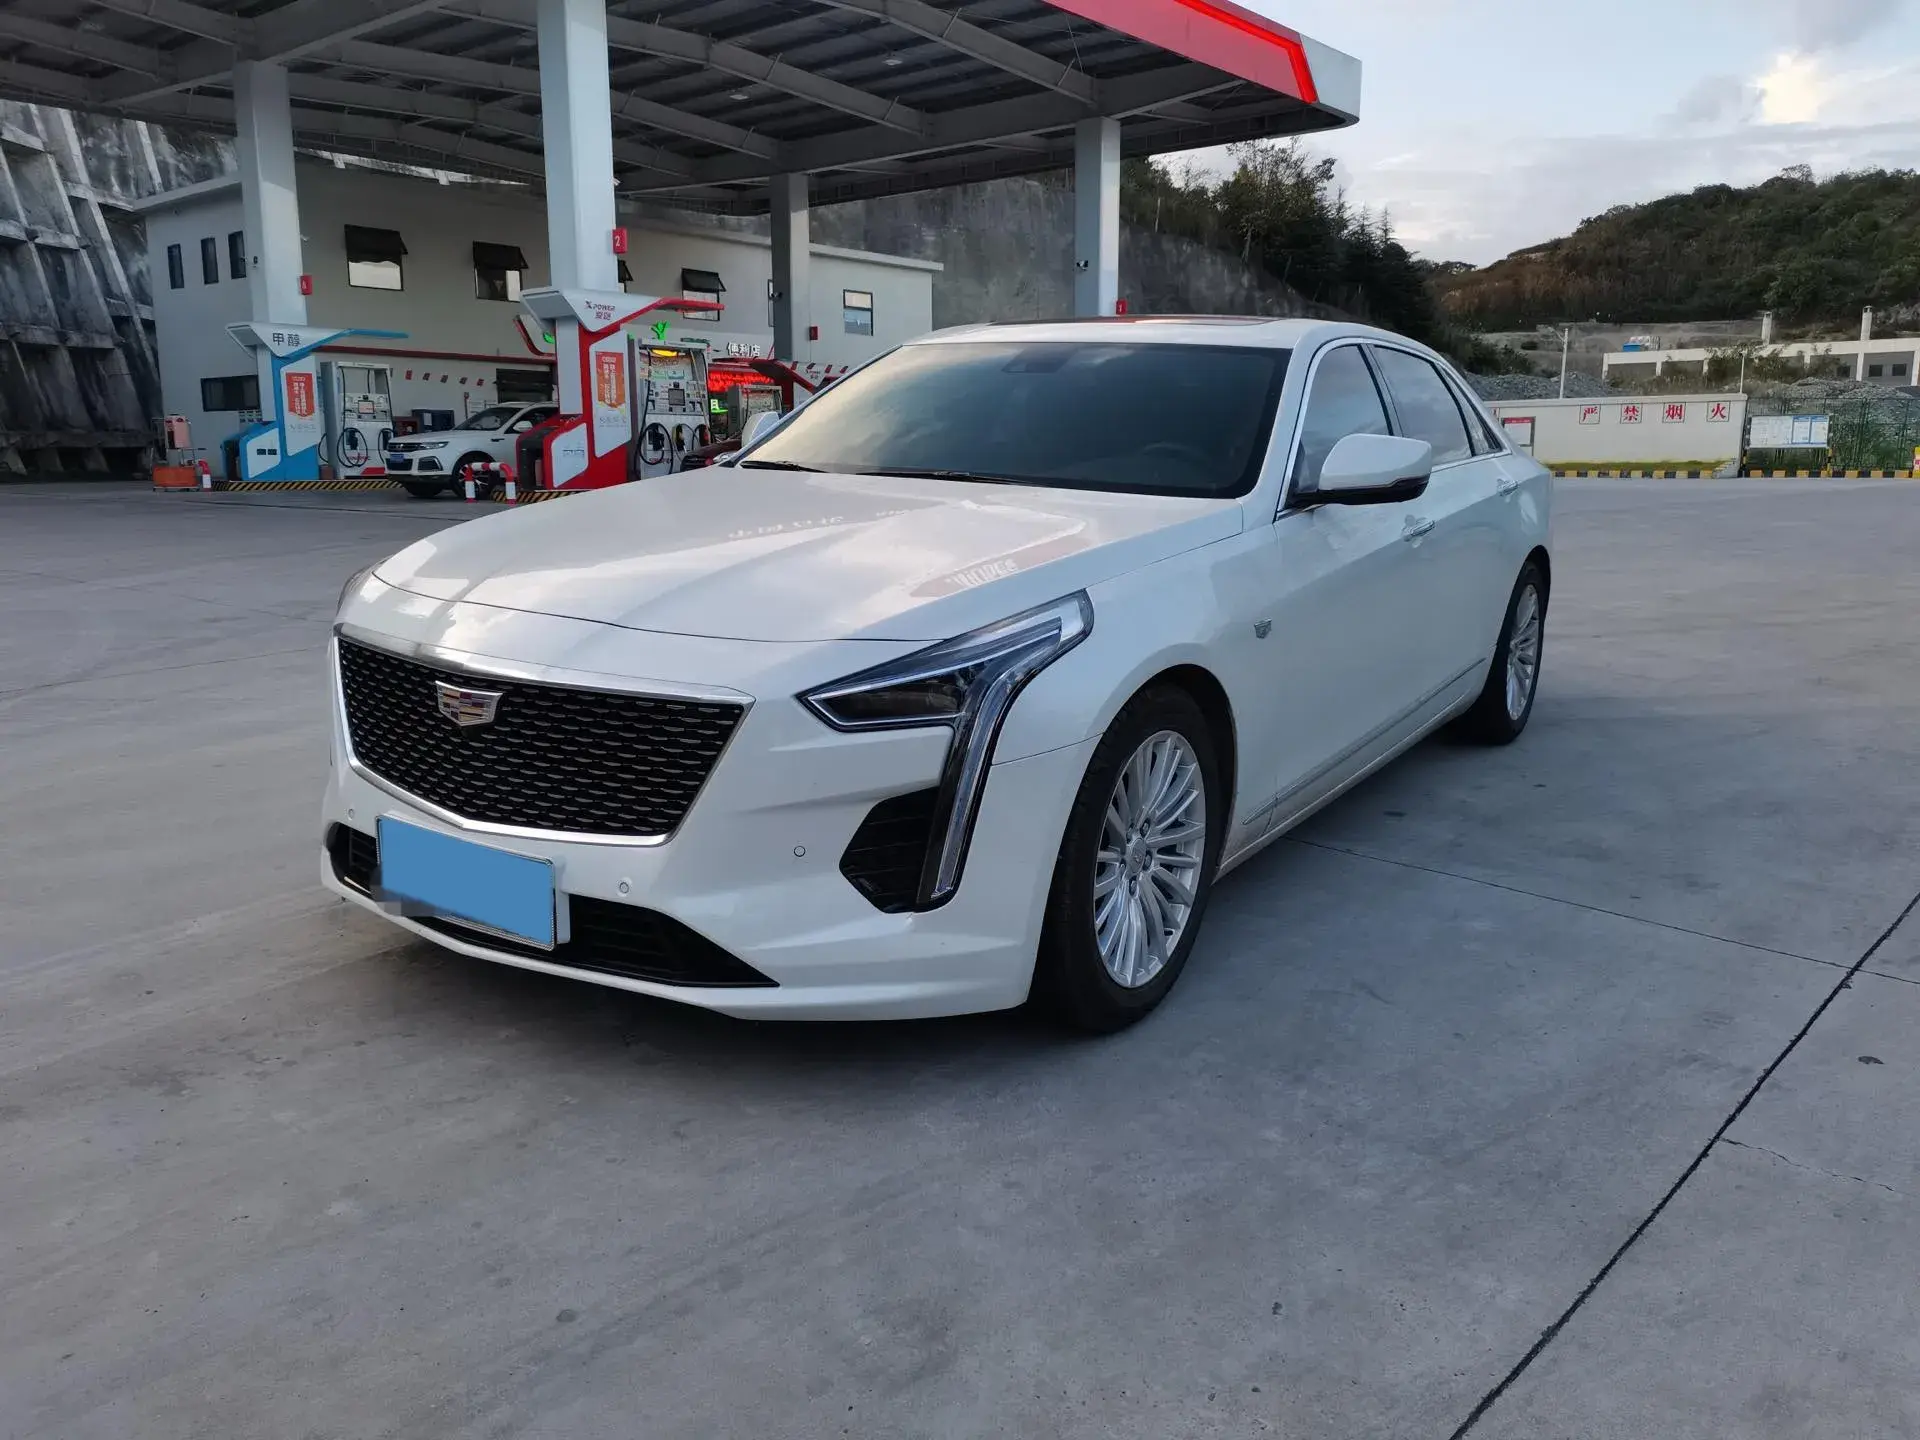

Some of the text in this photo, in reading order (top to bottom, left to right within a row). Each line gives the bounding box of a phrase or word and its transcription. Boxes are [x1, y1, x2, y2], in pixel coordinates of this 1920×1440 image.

[615, 235, 621, 247] 2
[272, 332, 301, 347] 甲醇
[728, 342, 761, 357] 便利店
[1582, 403, 1727, 422] 严禁烟火
